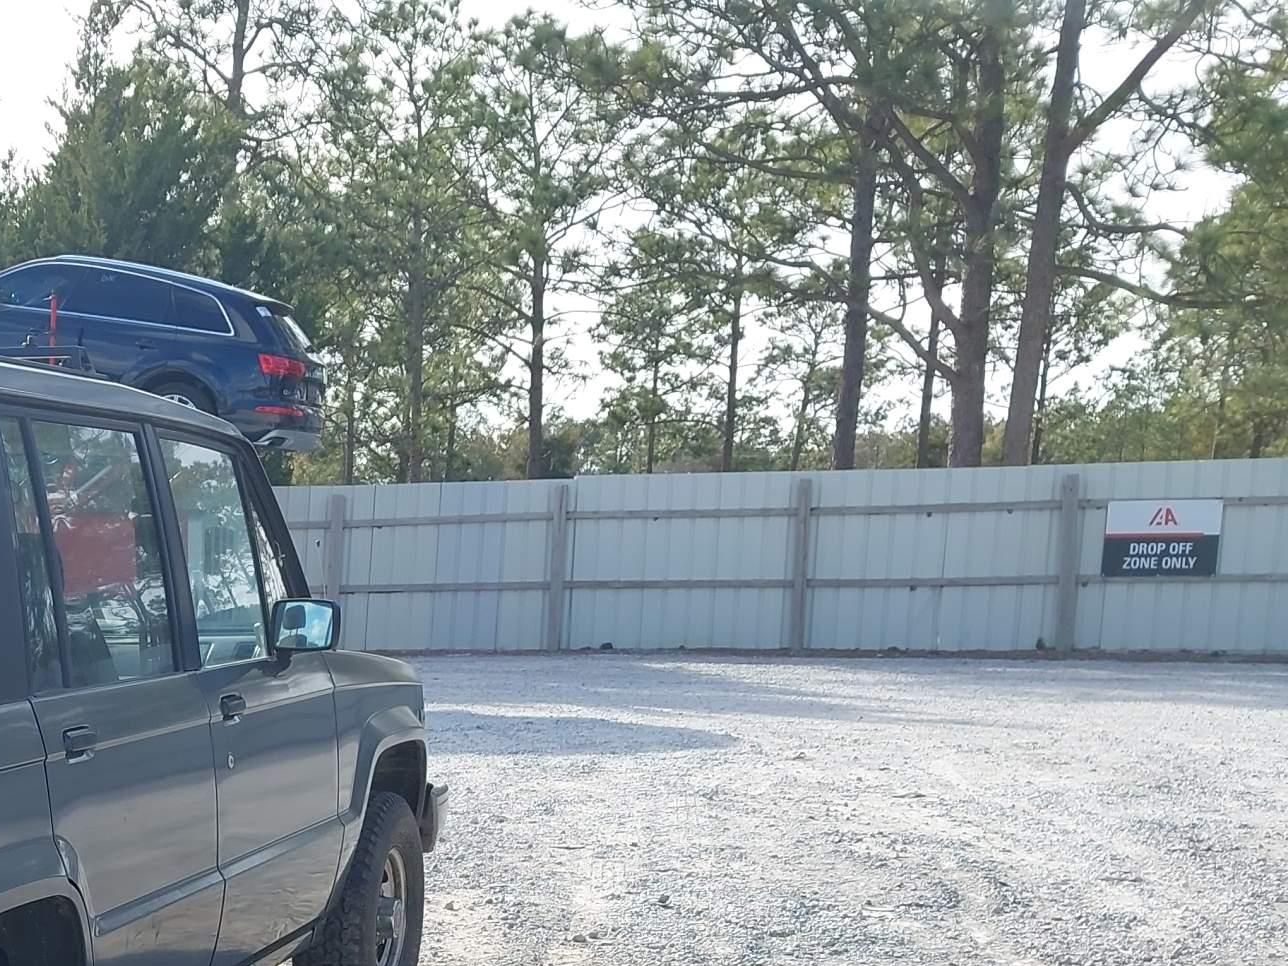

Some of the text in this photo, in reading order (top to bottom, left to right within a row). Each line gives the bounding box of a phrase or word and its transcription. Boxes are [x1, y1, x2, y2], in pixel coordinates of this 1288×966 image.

[1129, 542, 1193, 555] DROP OFF
[1122, 556, 1197, 569] ZONE ONLY
